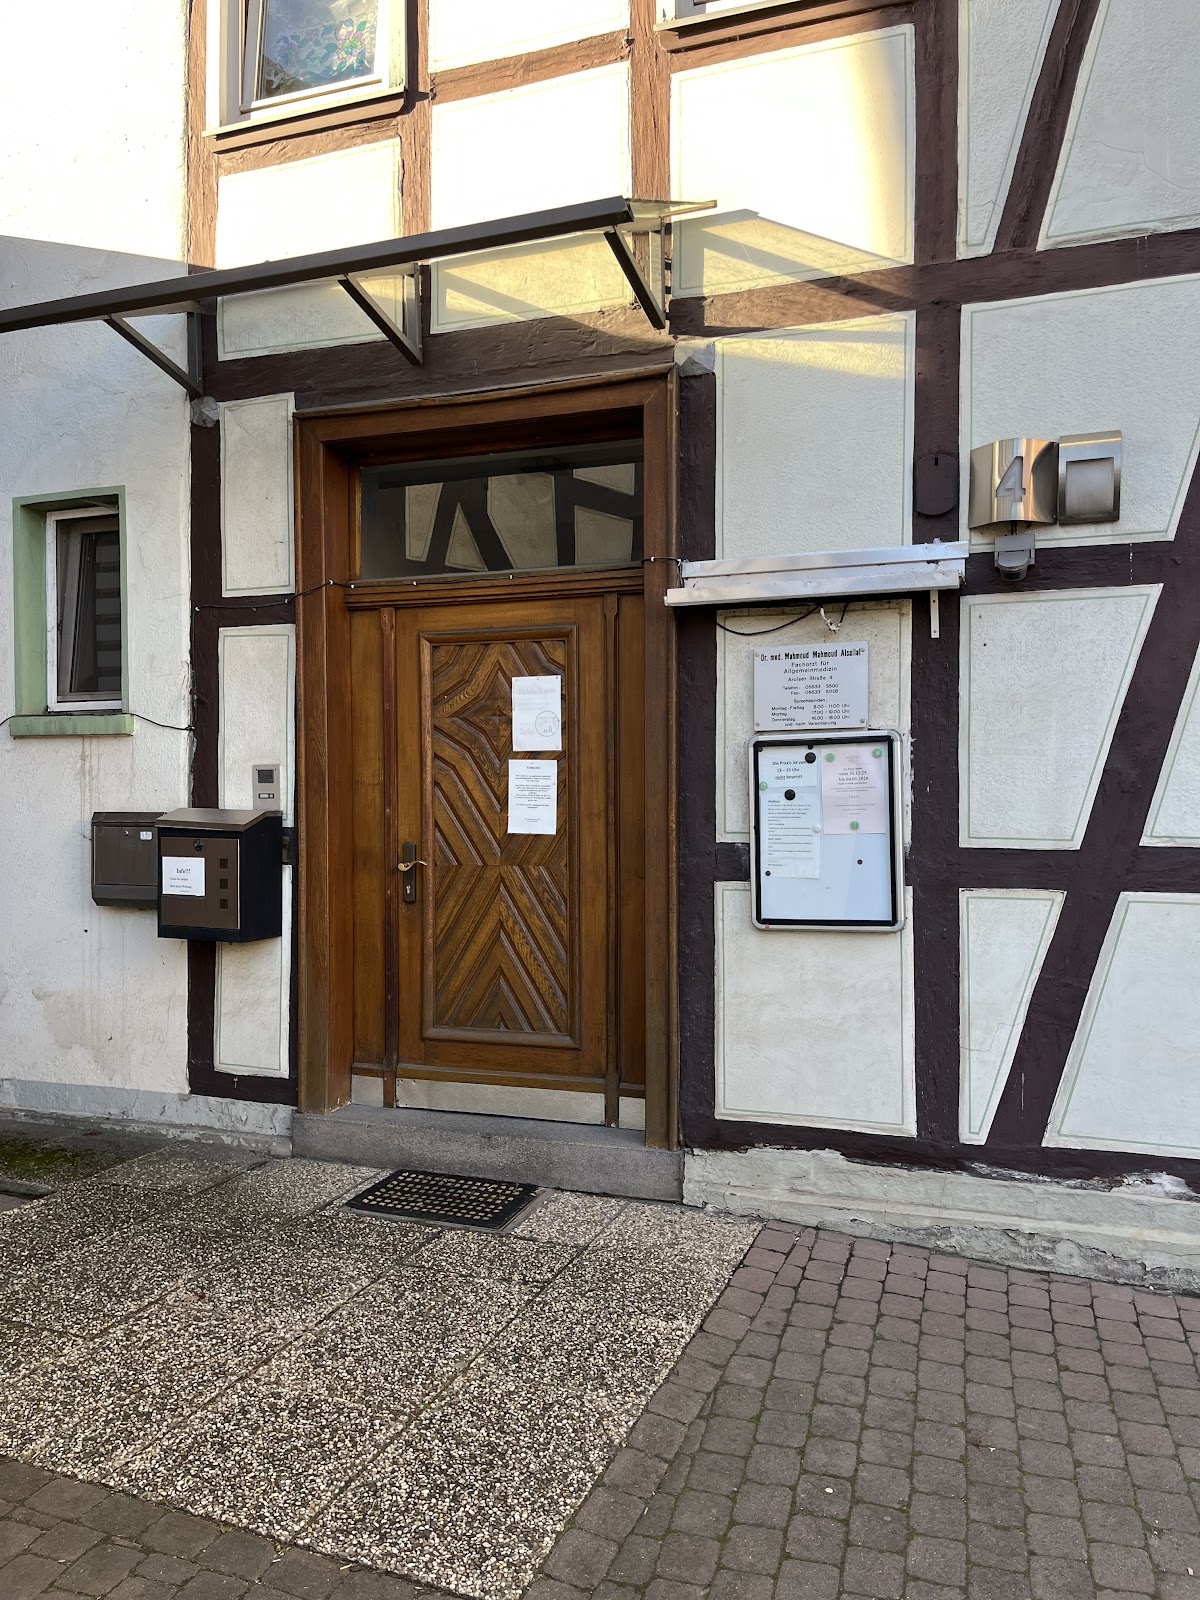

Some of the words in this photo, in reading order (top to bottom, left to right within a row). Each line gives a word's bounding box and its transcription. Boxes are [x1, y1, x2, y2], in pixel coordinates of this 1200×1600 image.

[995, 455, 1026, 503] 4
[760, 653, 769, 662] Dr.
[770, 653, 783, 661] med.
[784, 652, 809, 660] Mahmoud
[812, 650, 838, 658] Mahmoud
[783, 666, 838, 674] Allgemeinmedizin
